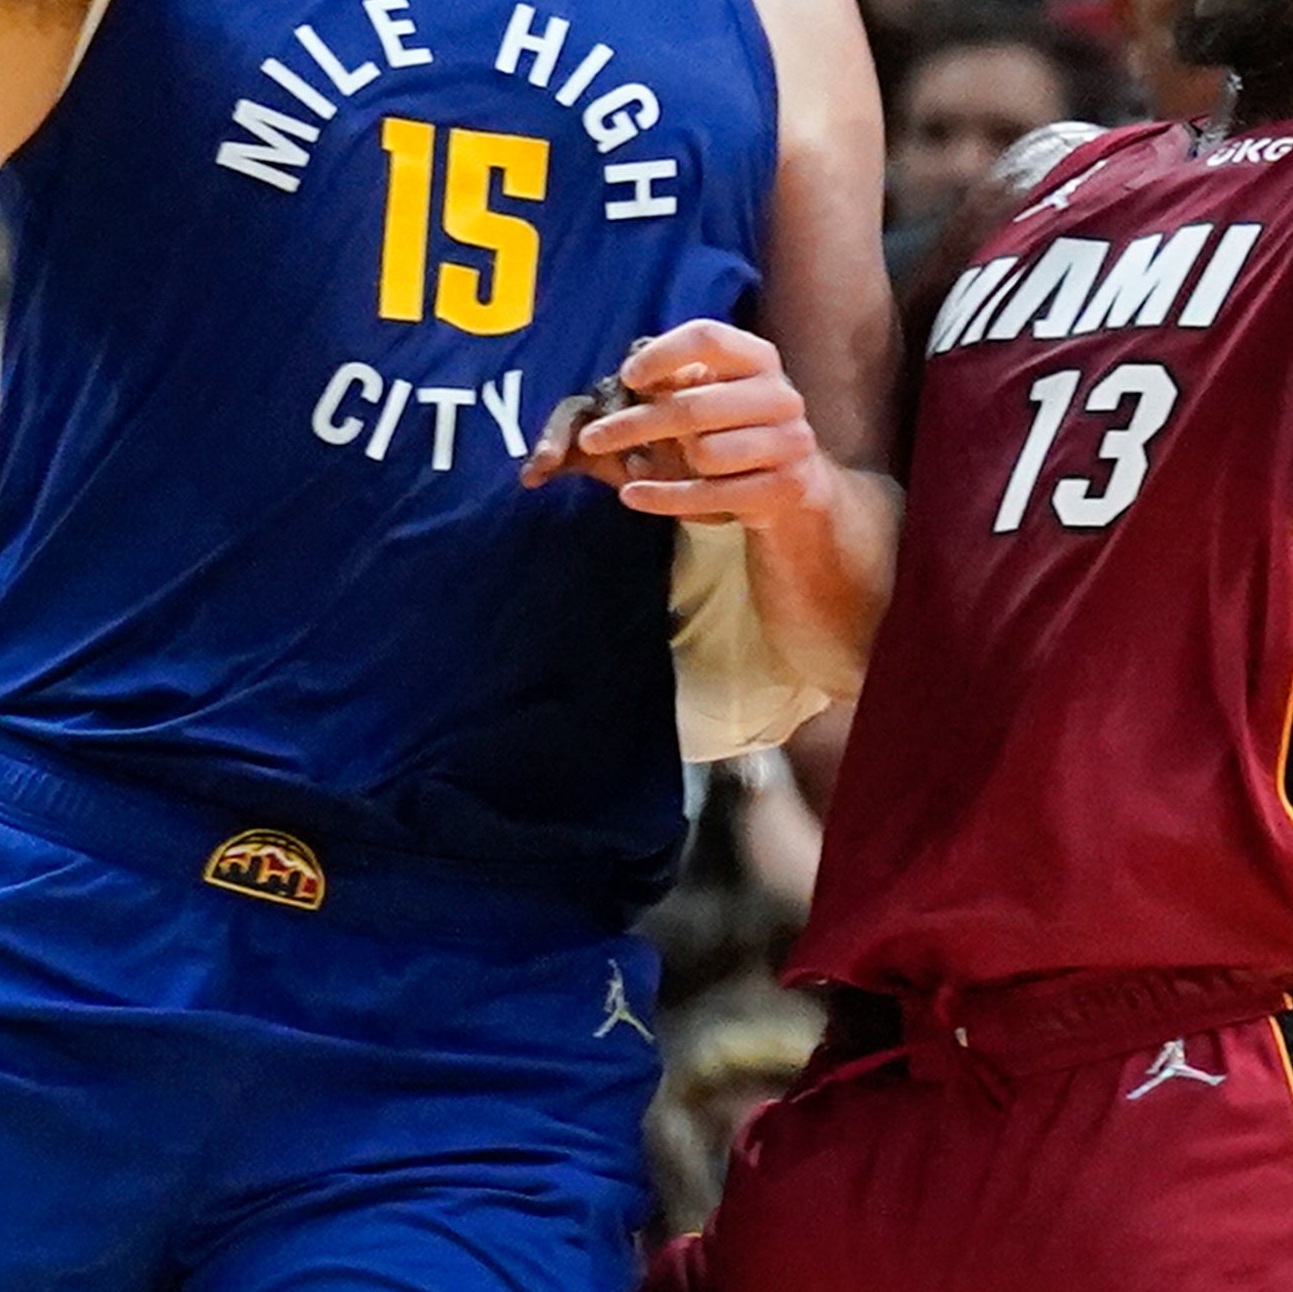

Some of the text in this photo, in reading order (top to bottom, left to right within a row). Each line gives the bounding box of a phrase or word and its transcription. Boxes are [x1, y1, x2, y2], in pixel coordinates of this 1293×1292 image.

[494, 2, 678, 220] HIGH
[378, 115, 550, 337] 15
[925, 222, 1264, 361] MIAMI
[311, 361, 528, 472] CITY
[992, 362, 1179, 534] 13
